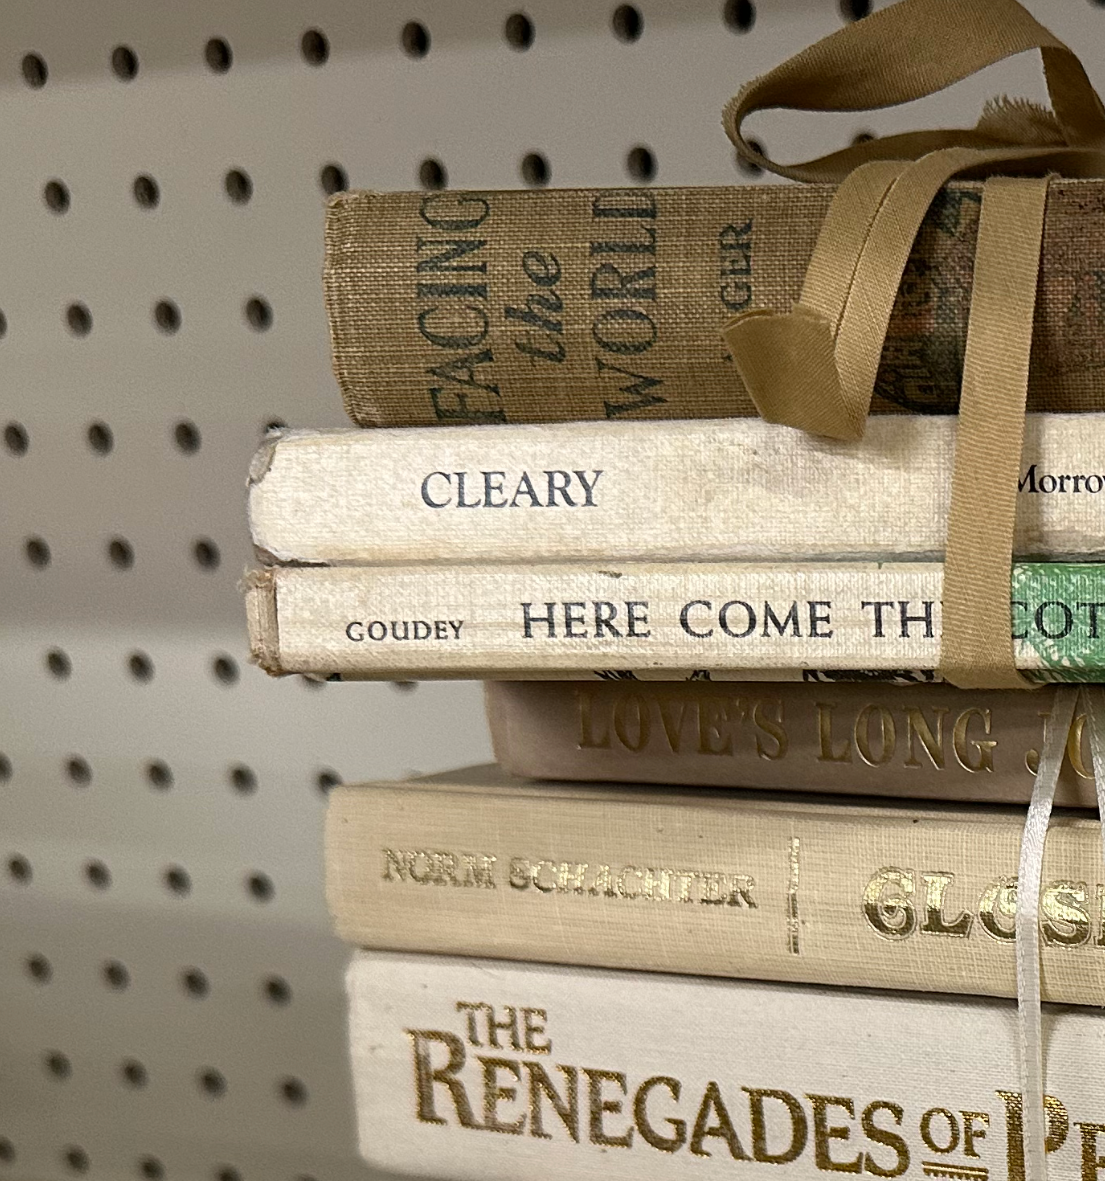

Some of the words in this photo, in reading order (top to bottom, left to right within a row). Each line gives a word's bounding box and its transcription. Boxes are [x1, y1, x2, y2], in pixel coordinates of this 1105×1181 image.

[416, 189, 507, 421] FACING
[503, 250, 566, 367] the
[419, 468, 604, 511] CLEARY
[345, 619, 465, 643] GOUDEY
[521, 600, 651, 640] HERE
[679, 600, 834, 641] COME
[861, 600, 944, 640] TH
[577, 690, 789, 761] LOVE'S
[814, 701, 998, 774] LONG
[381, 846, 498, 890] NORM
[508, 855, 759, 910] SCHACHTER
[455, 1000, 553, 1057] THE
[405, 1027, 911, 1180] RENEGADES
[919, 1105, 991, 1162] OF
